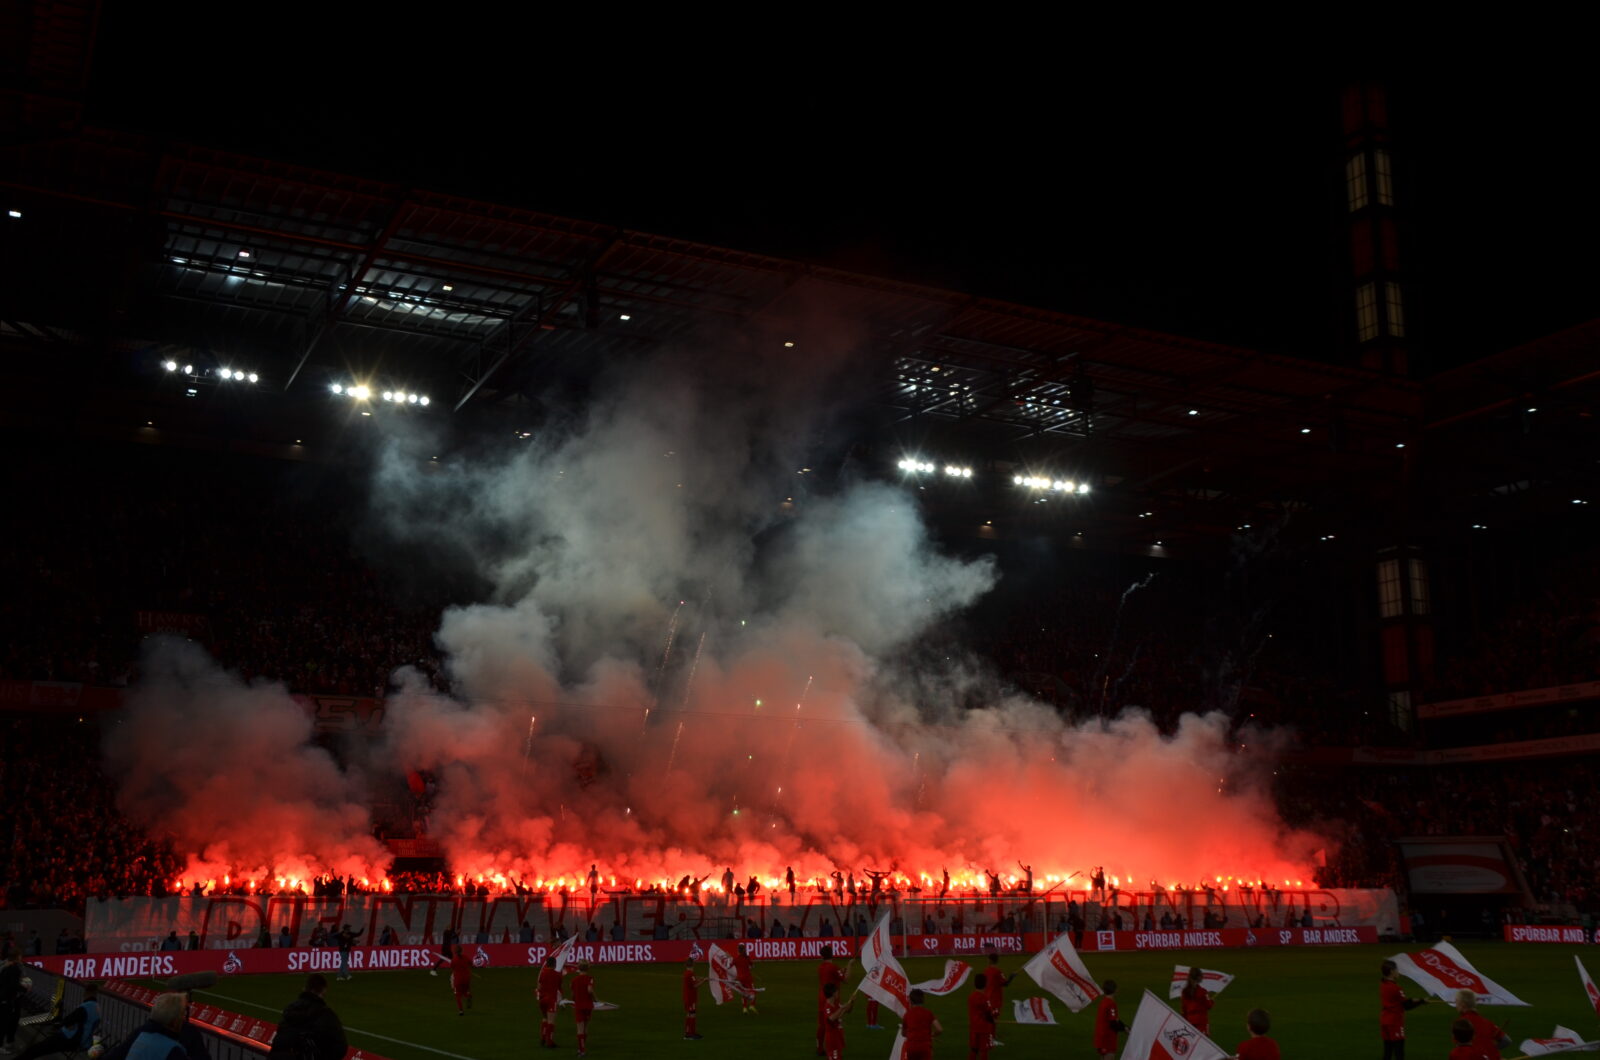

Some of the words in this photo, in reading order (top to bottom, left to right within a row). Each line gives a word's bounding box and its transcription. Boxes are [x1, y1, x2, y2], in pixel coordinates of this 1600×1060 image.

[1135, 931, 1180, 948] SPÜRBAR
[1183, 931, 1225, 947] ANDERS.
[1323, 929, 1361, 943] ANDERS.
[1511, 925, 1561, 942] SPÜRBAR
[598, 944, 657, 962] ANDERS.
[738, 939, 797, 958] PÜRBAR
[63, 958, 97, 979] BAR
[100, 955, 179, 977] ANDERS.
[368, 949, 435, 968] ANDERS.
